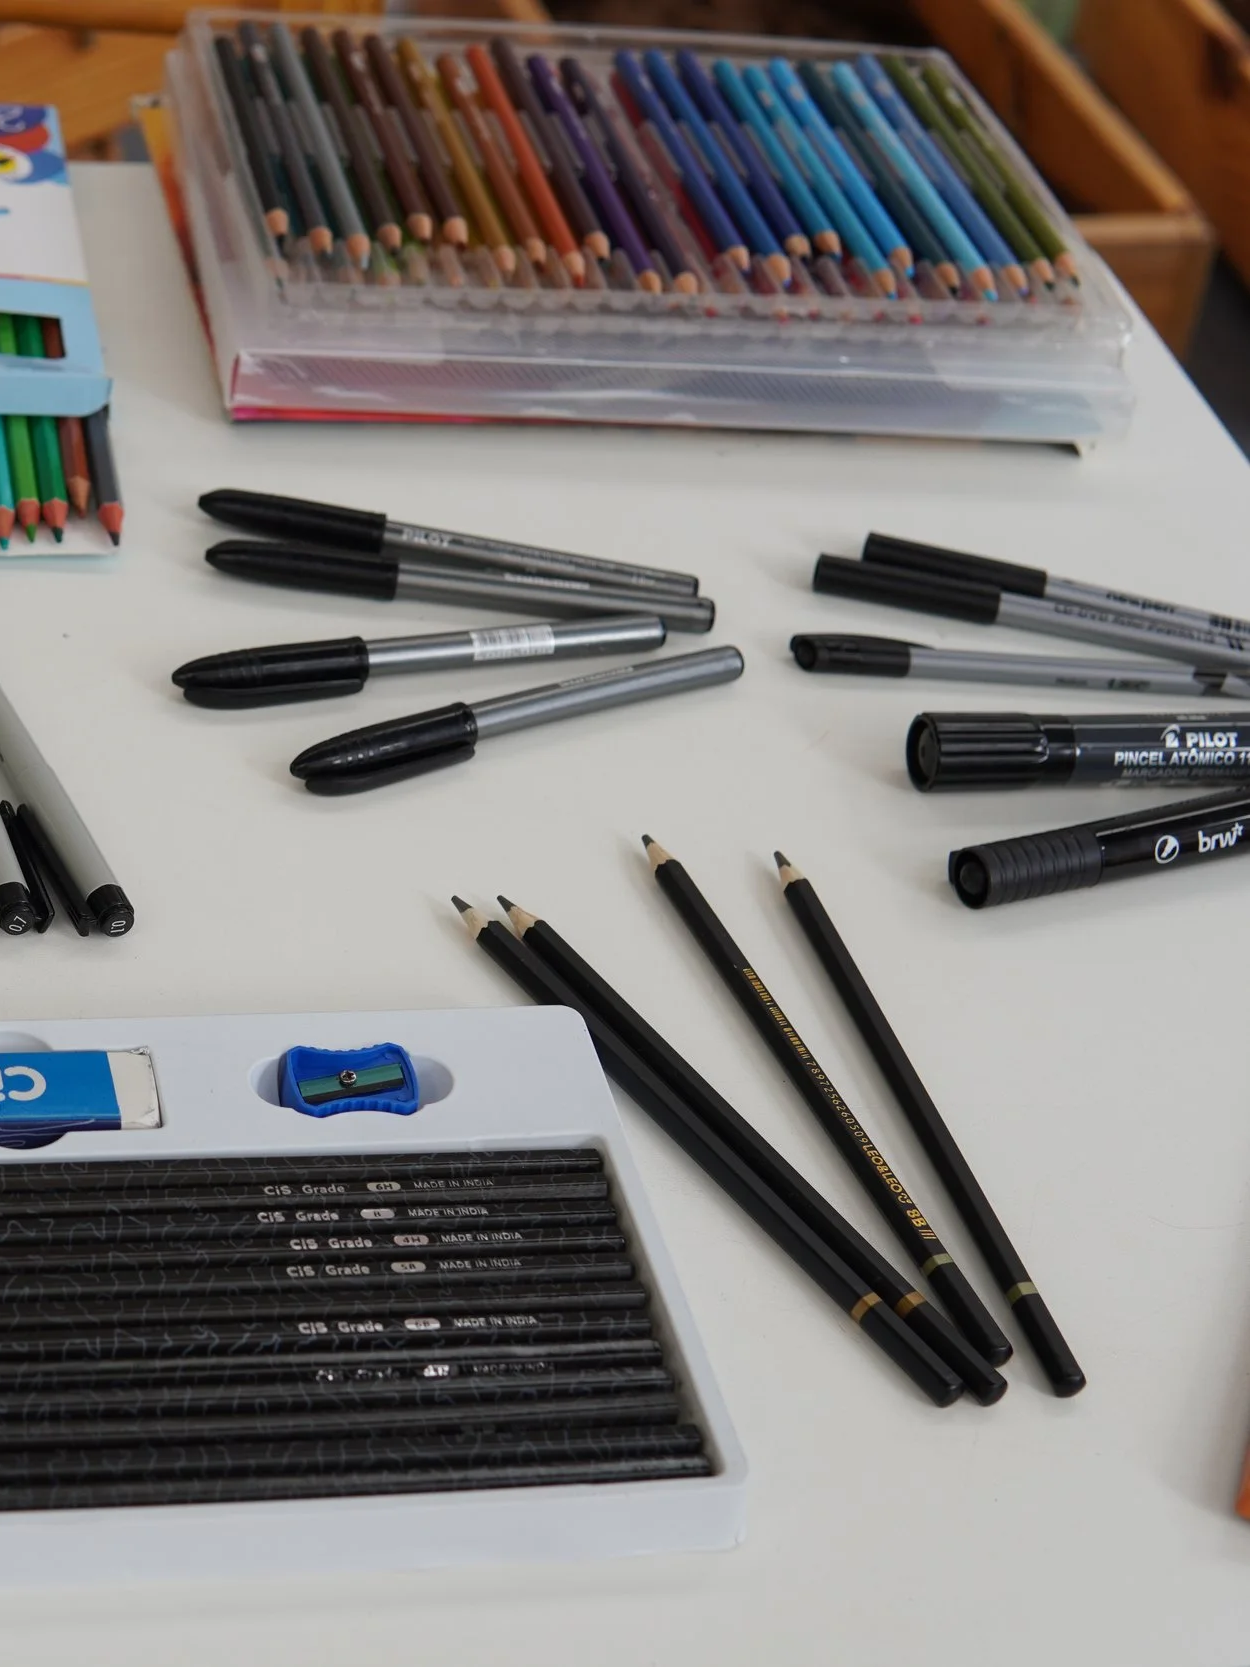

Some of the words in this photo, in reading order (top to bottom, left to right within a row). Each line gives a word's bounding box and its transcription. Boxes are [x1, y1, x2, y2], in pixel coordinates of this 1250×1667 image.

[1185, 732, 1238, 748] PILOT
[1114, 751, 1166, 766] PINCEL
[1169, 748, 1236, 766] ATÔMICO
[8, 915, 29, 932] 0.7
[806, 1061, 869, 1143] 7897256260509
[862, 1144, 903, 1193] LEO&LEO
[906, 1208, 927, 1227] 8B
[302, 1183, 346, 1195] Grade
[413, 1180, 446, 1189] MADE
[449, 1180, 460, 1188] IN
[463, 1178, 494, 1187] INDIA
[295, 1209, 340, 1221] Grade
[408, 1208, 440, 1217] MADE
[443, 1207, 455, 1217] IN
[458, 1206, 490, 1216] INDIA
[328, 1236, 373, 1249] Grade
[440, 1233, 472, 1243] MADE
[476, 1233, 489, 1241] IN
[491, 1231, 523, 1240] INDIA
[325, 1263, 371, 1276] Grade
[438, 1260, 471, 1270] MADE
[475, 1259, 488, 1268] IN
[490, 1258, 522, 1267] INDIA
[338, 1320, 384, 1333] Grade
[453, 1317, 486, 1328] MADE
[490, 1316, 502, 1326] IN
[505, 1315, 537, 1325] INDIA
